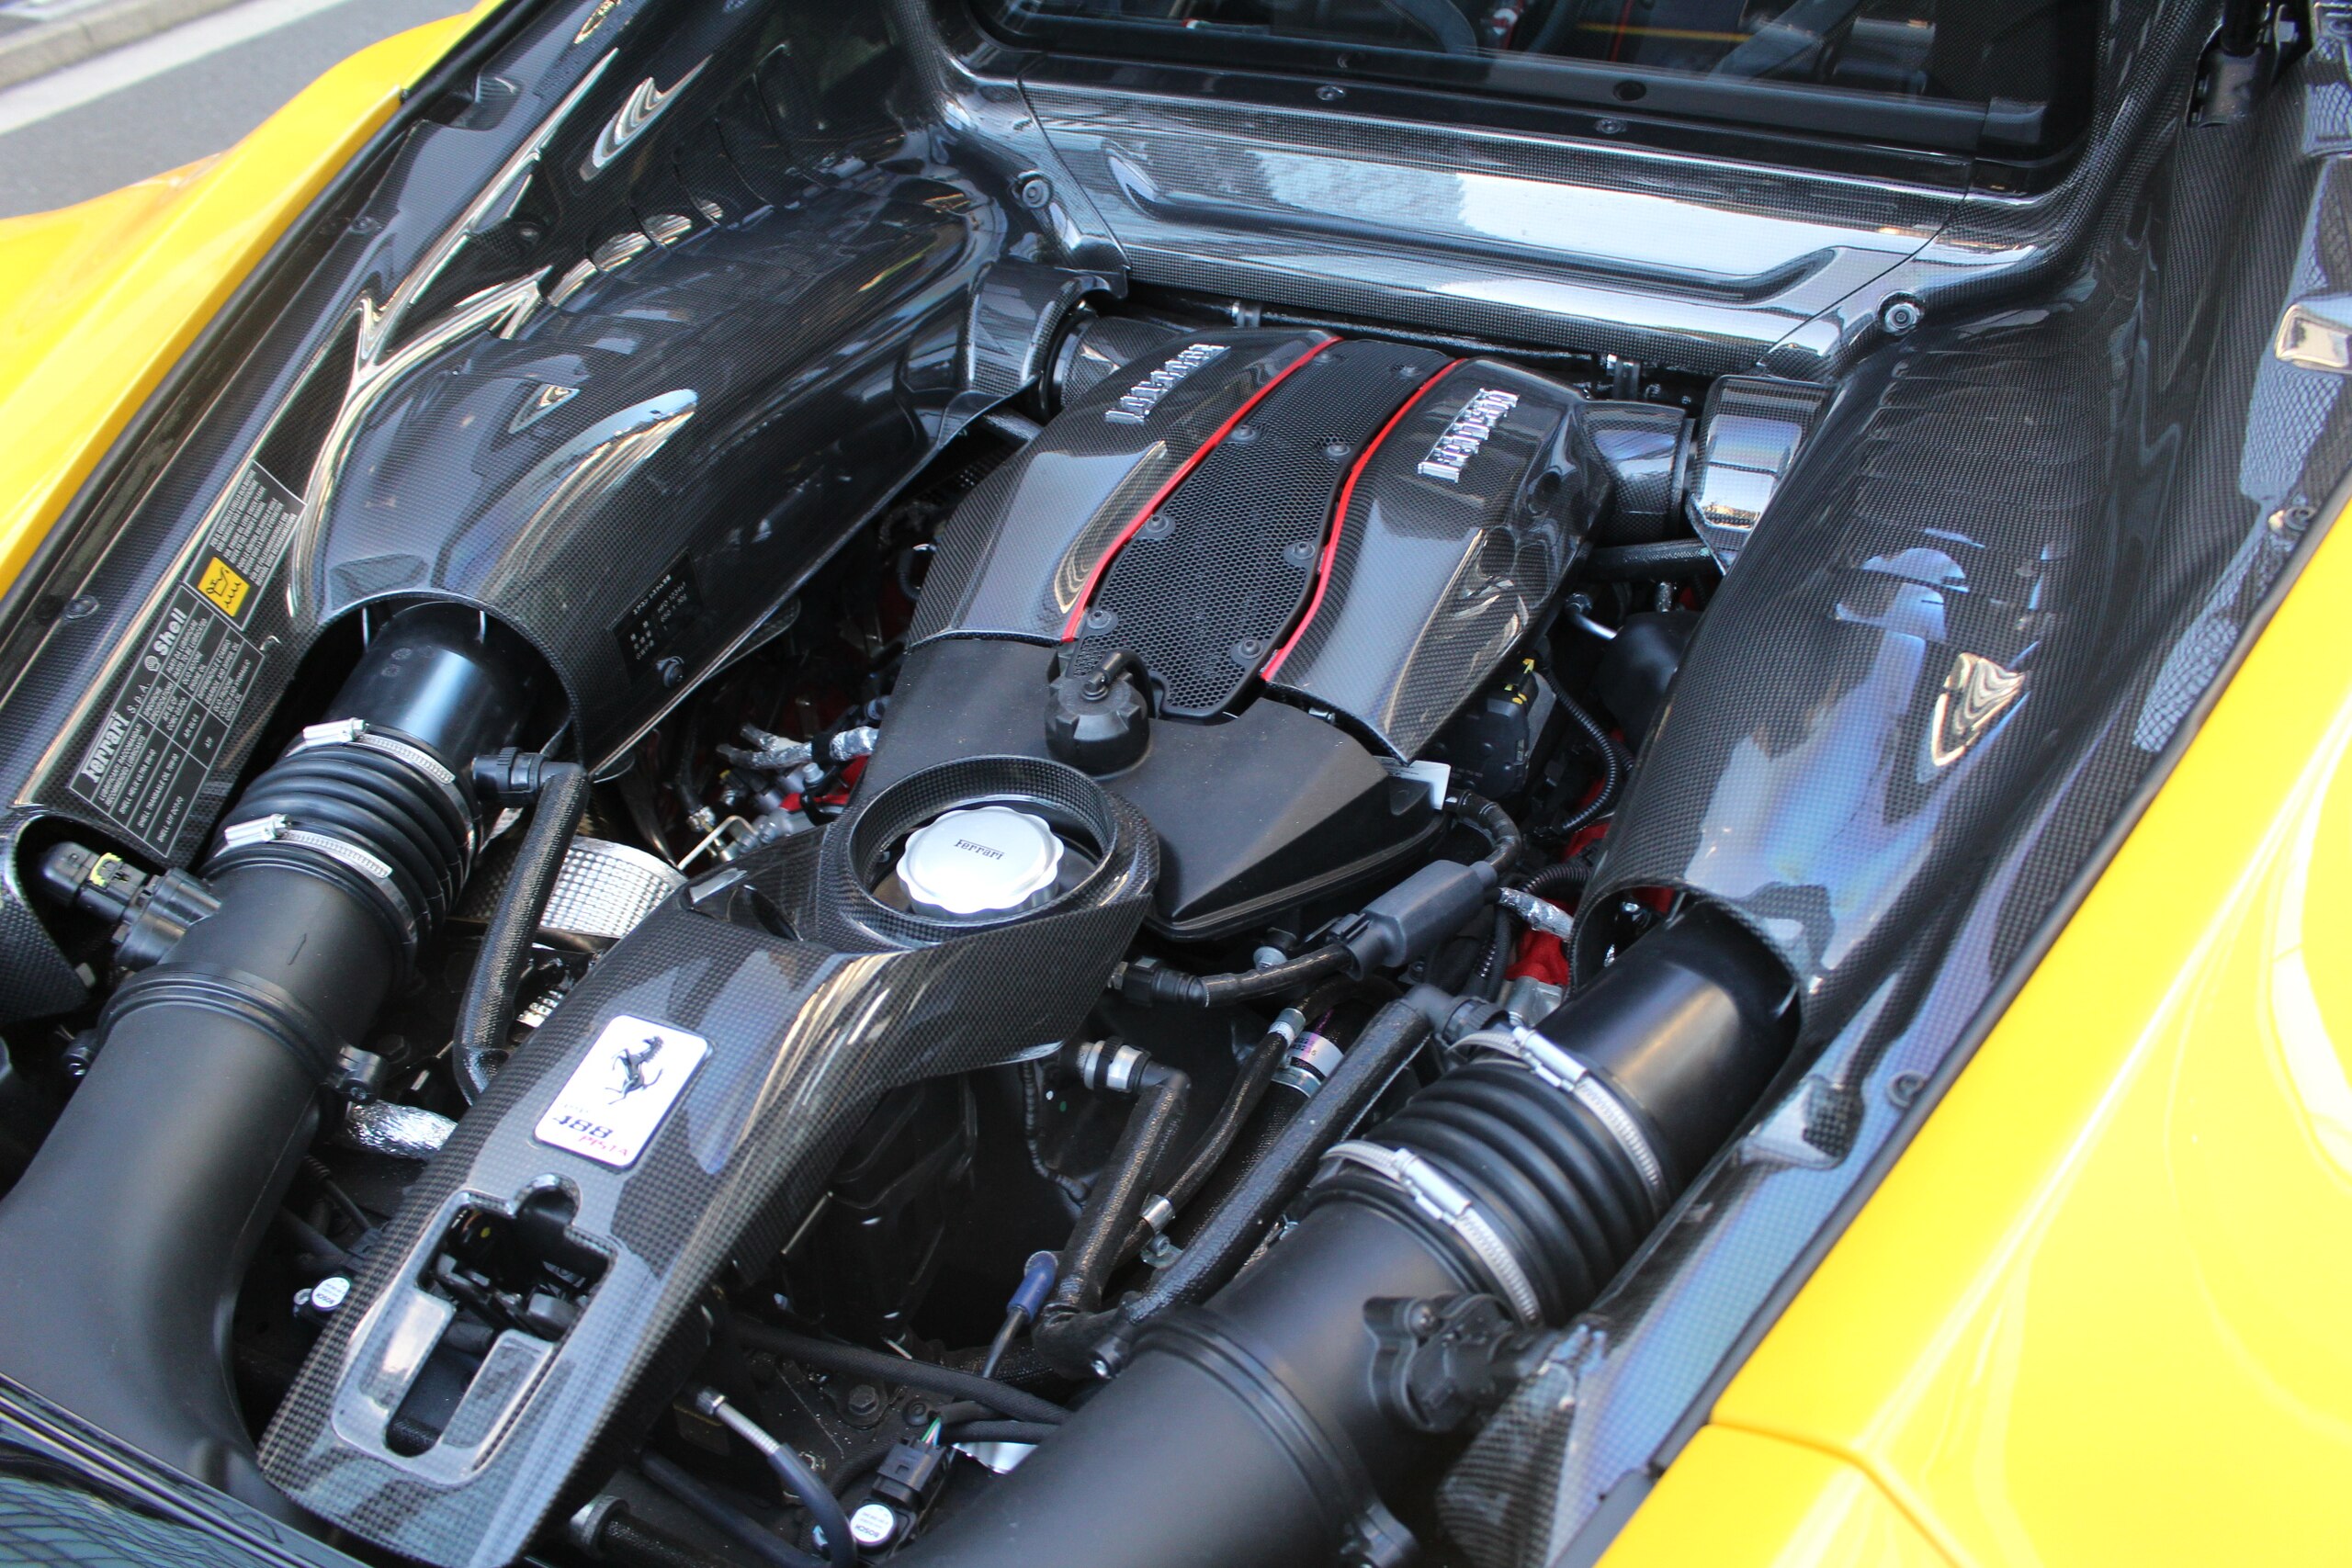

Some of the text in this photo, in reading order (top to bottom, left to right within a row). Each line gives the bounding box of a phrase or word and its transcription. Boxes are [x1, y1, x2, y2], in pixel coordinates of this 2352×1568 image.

[153, 608, 187, 660] Shell
[81, 712, 130, 785] Ferrari
[119, 797, 130, 813] SHELL
[137, 811, 149, 827] SHELL
[157, 825, 168, 841] SHELL
[954, 839, 1005, 860] Ferrari
